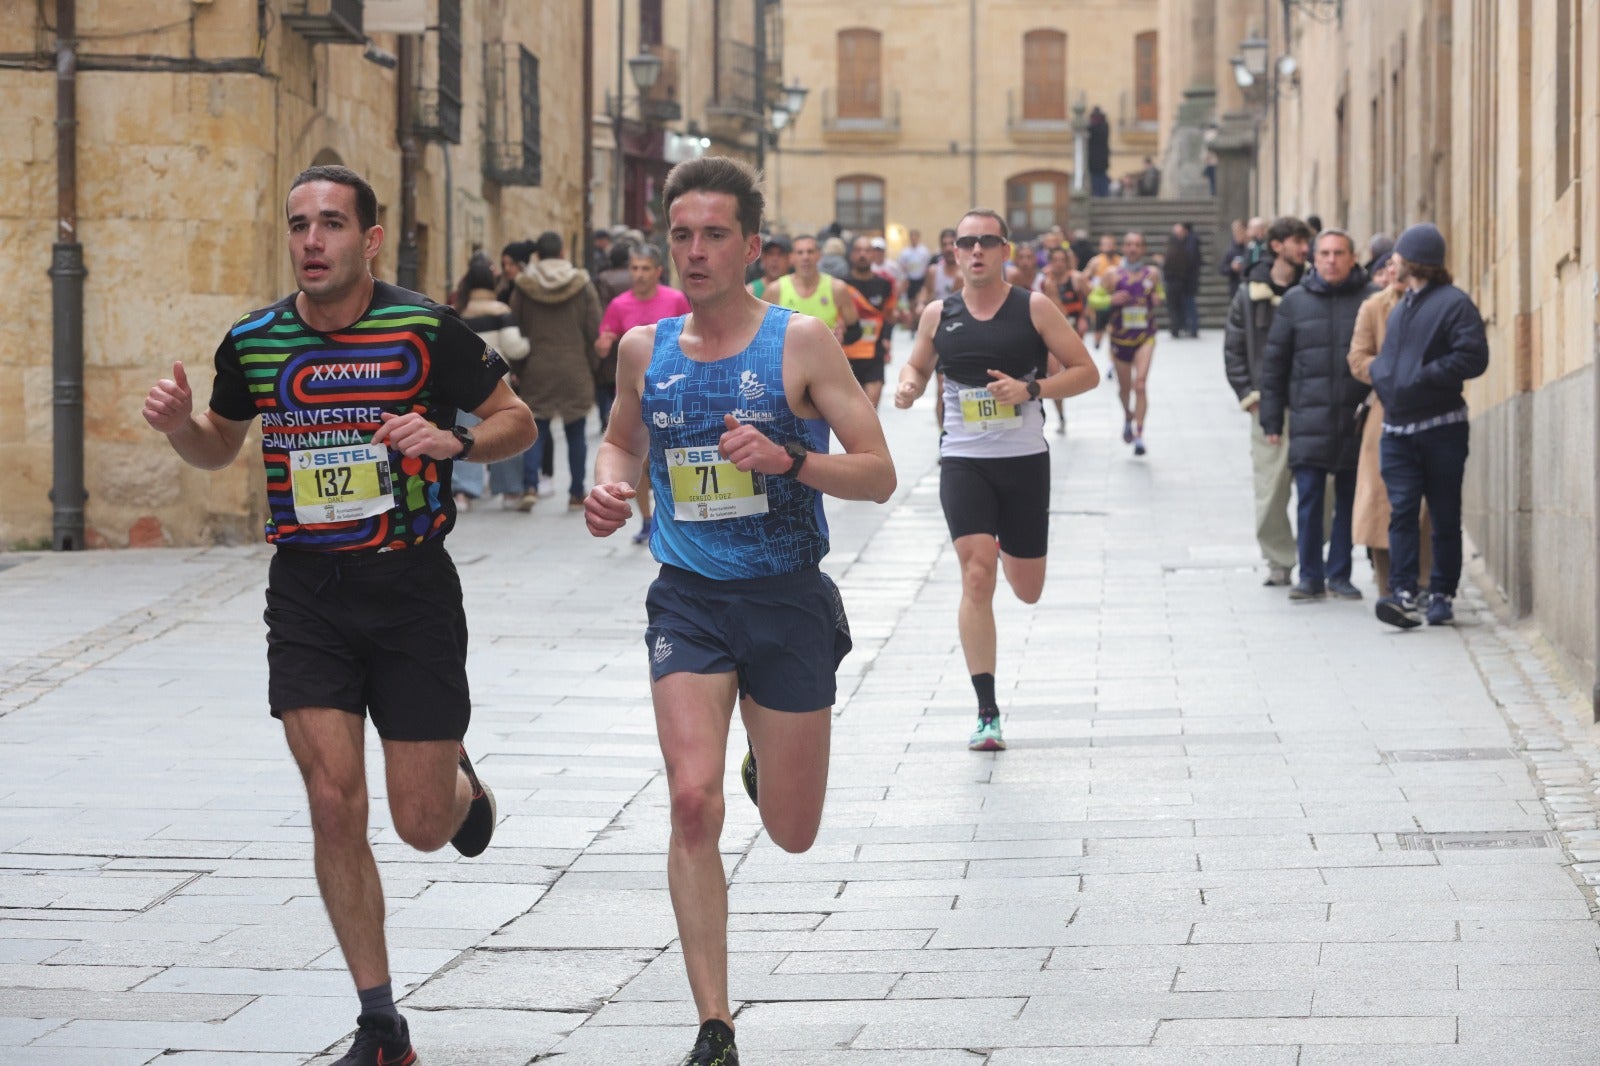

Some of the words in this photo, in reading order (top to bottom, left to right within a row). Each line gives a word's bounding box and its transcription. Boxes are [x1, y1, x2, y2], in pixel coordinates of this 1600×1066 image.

[311, 363, 381, 382] XXXVIII
[284, 406, 381, 428] SILVESTRE
[978, 400, 998, 417] 161
[262, 428, 364, 449] SALMANTINA
[314, 448, 377, 466] SETEL
[688, 449, 724, 463] SET
[315, 467, 354, 497] 132
[695, 465, 719, 494] 71
